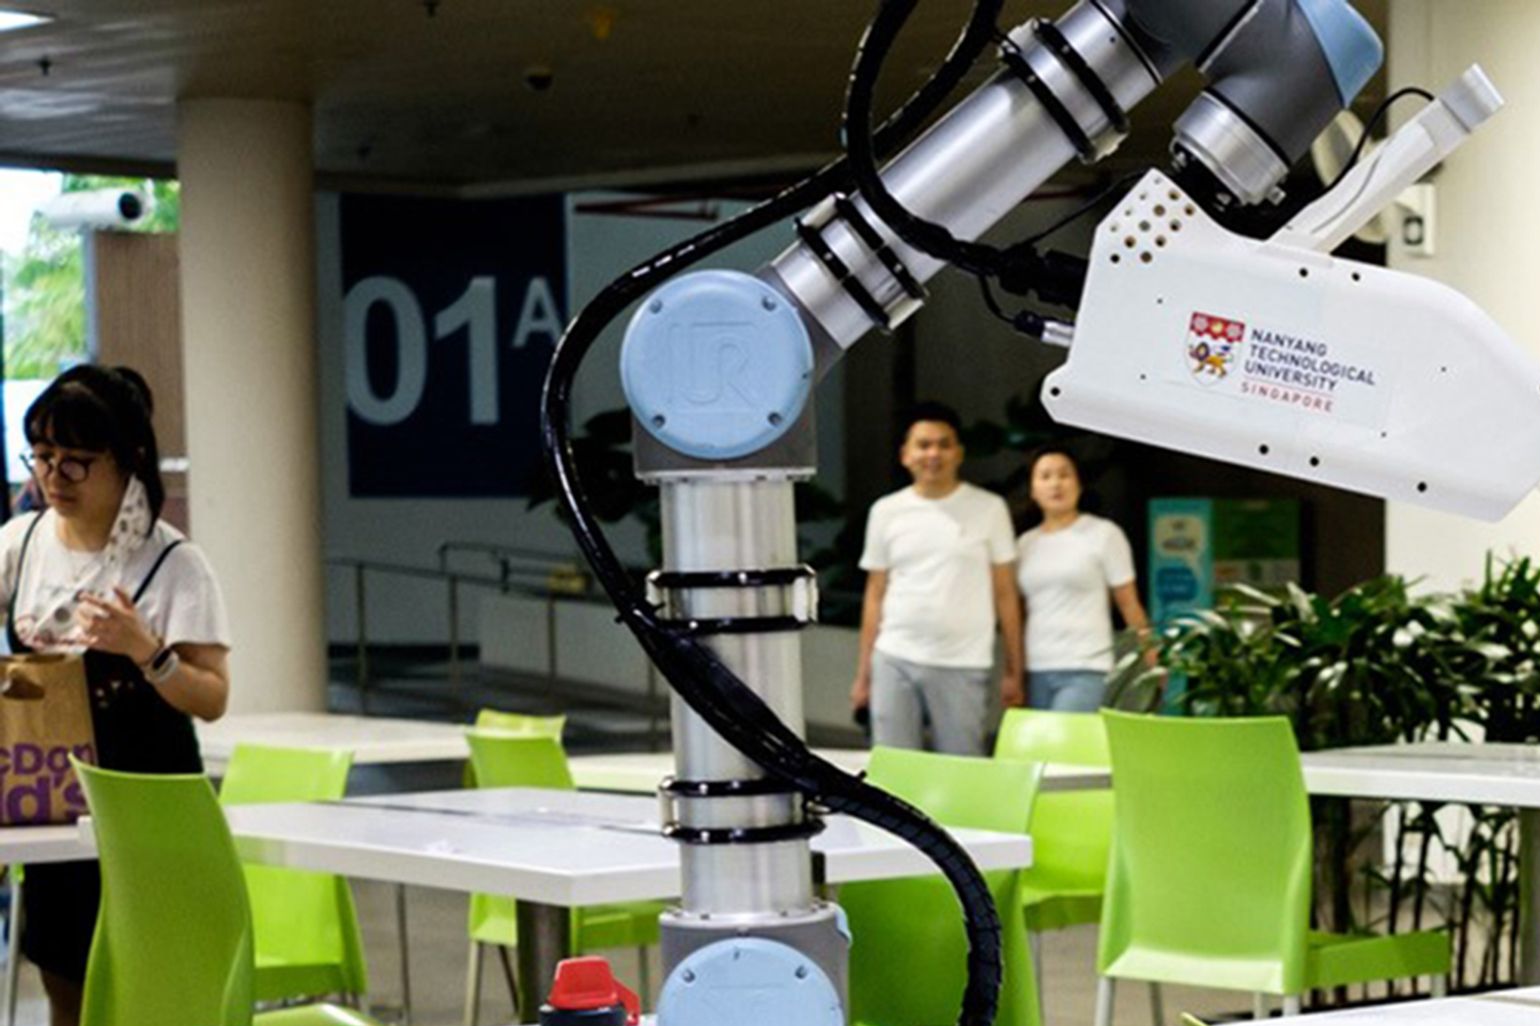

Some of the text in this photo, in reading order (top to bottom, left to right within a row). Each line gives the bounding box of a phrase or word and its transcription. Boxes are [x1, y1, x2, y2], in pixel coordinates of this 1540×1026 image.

[1251, 329, 1327, 356] NANYANG
[1245, 361, 1337, 391] UNIVERSITY
[1249, 344, 1374, 385] TECHNOLOGICAL
[1242, 382, 1332, 411] SINGAPORE
